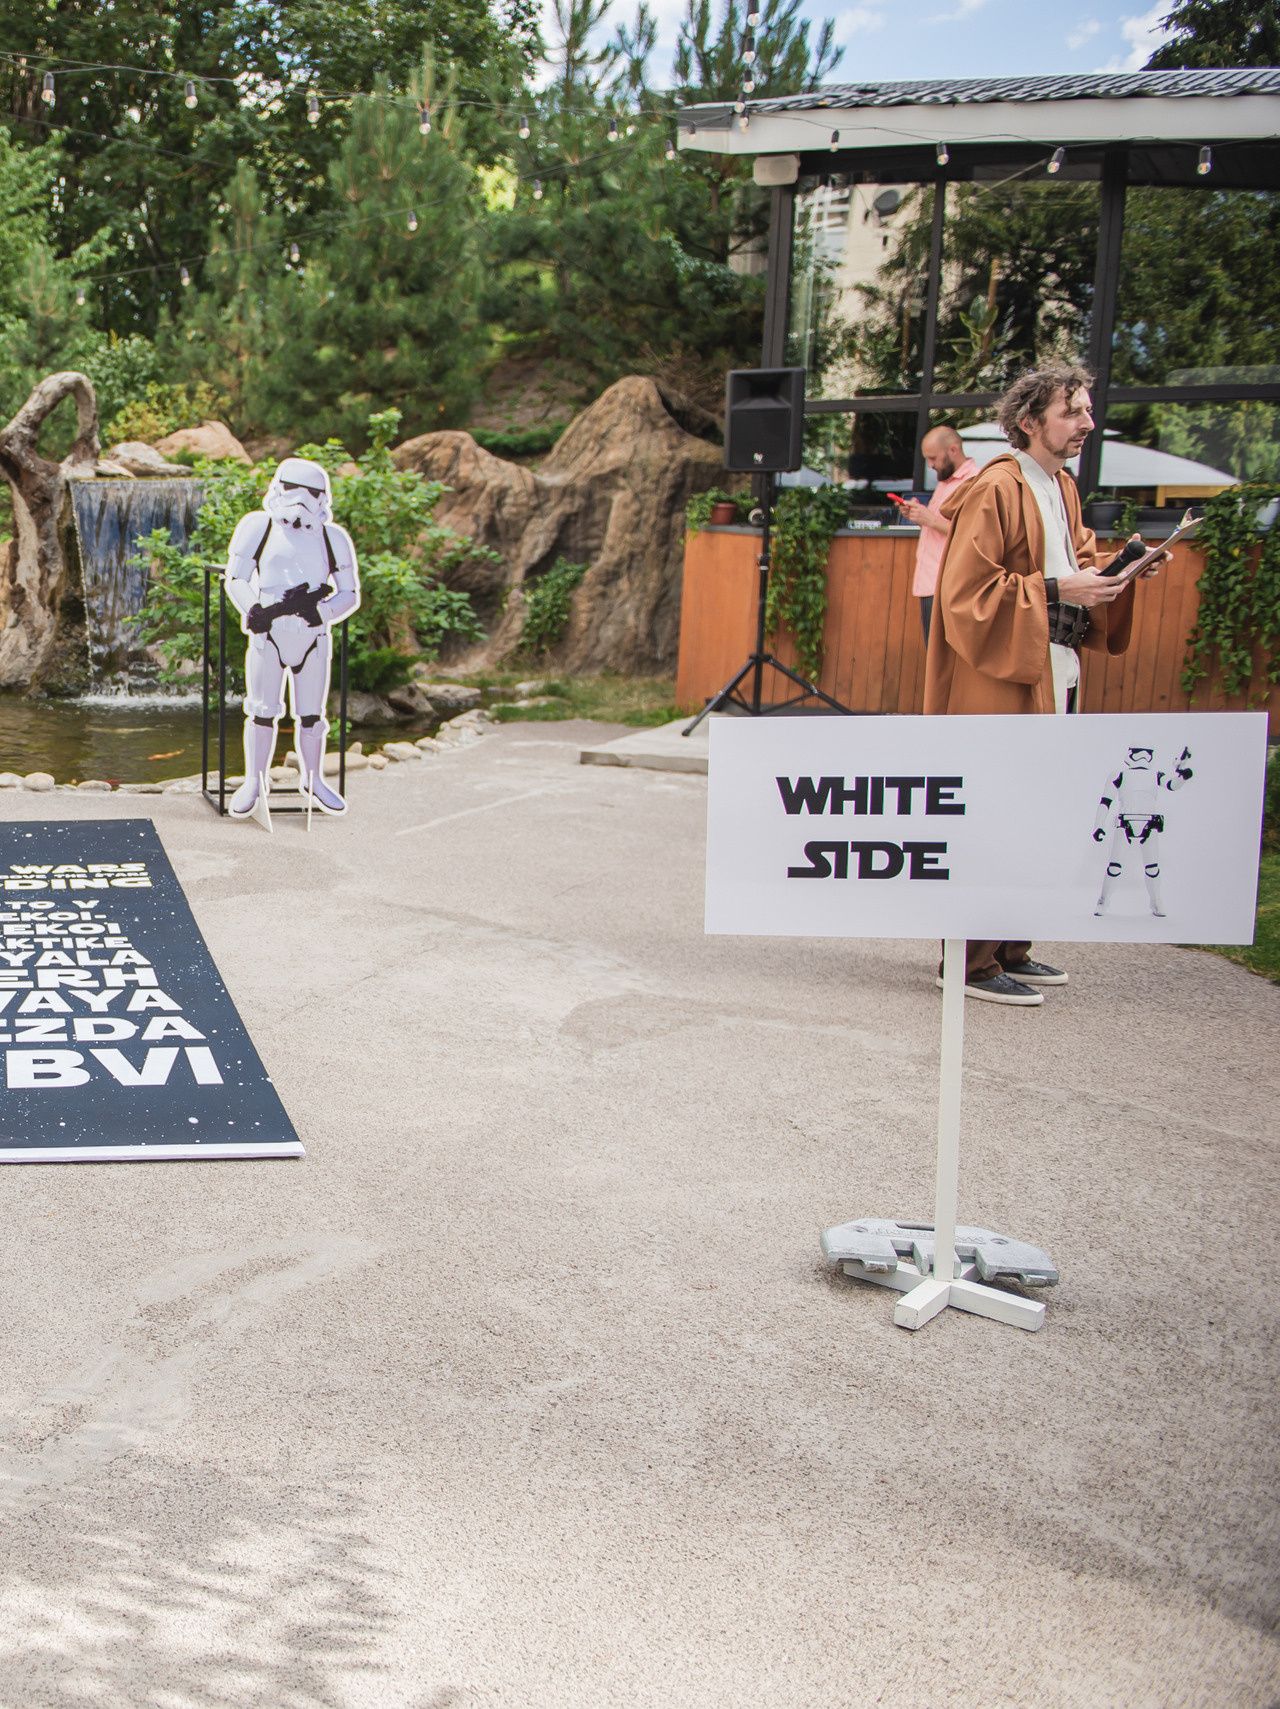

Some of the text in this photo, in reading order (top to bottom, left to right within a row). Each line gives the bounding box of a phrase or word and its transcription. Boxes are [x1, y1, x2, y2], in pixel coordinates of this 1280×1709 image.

[775, 776, 966, 816] WHITE
[9, 863, 146, 874] WARS
[787, 841, 950, 881] SIDE
